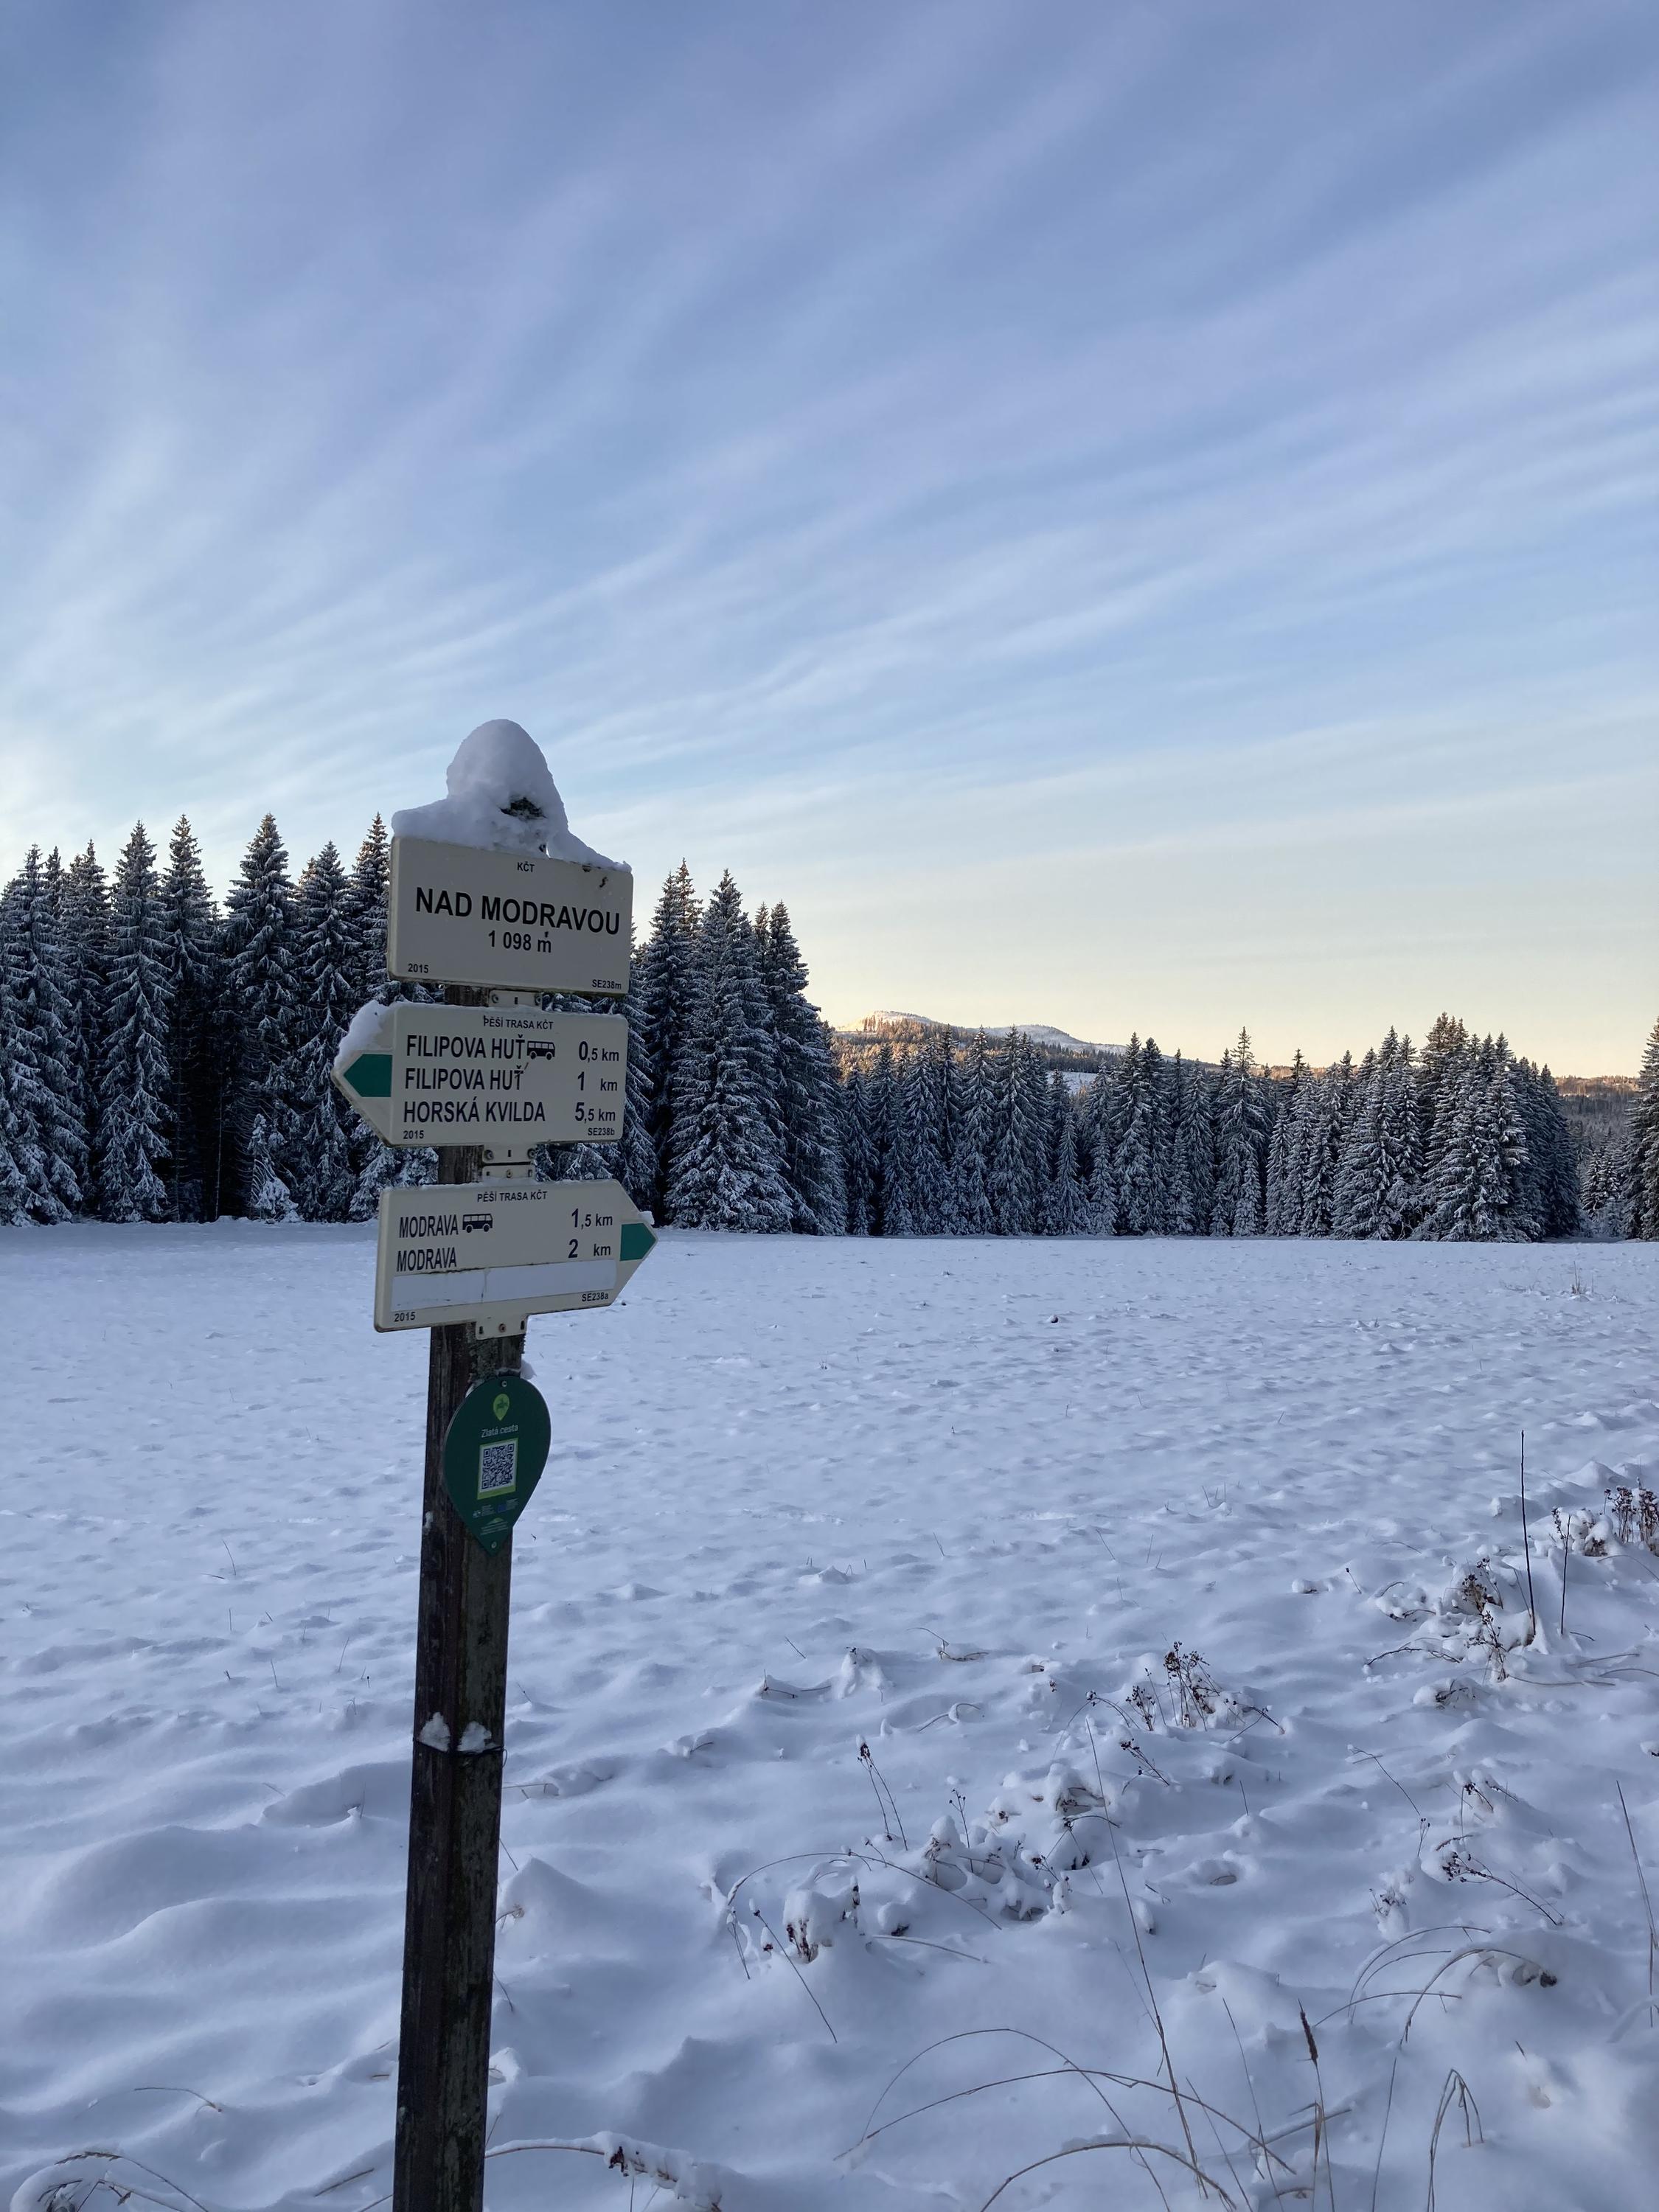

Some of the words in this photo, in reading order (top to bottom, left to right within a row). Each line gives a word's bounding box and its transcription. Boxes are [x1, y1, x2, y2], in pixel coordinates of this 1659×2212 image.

[517, 860, 535, 874] KČT
[416, 886, 472, 917] NAD
[481, 895, 620, 935] MODRAVOU
[488, 931, 495, 947] 1
[503, 933, 532, 951] 098
[537, 937, 552, 953] m
[408, 963, 429, 974] 2015
[591, 978, 622, 990] SE238m
[505, 1019, 535, 1029] TRASA
[536, 1018, 554, 1030] KČT
[406, 1034, 487, 1059] FILIPOVA
[491, 1034, 526, 1060] HUŤ
[578, 1040, 598, 1062] 0,5
[602, 1048, 619, 1062] km
[405, 1068, 484, 1090] FILIPOVA
[490, 1065, 524, 1091] HUŤ
[577, 1071, 585, 1091] 1
[600, 1079, 618, 1091] km
[403, 1096, 479, 1123] HORSKÁ
[485, 1102, 546, 1122] KVILDA
[575, 1102, 595, 1124] 5,5
[598, 1110, 616, 1121] km
[403, 1130, 424, 1140] 2015
[588, 1127, 615, 1136] SE238b
[499, 1192, 529, 1201] TRASA
[530, 1190, 547, 1201] KČT
[399, 1214, 459, 1239] MODRAVA
[571, 1208, 592, 1231] 1,5
[595, 1214, 613, 1227] km
[568, 1239, 579, 1259] 2
[593, 1245, 611, 1256] km
[396, 1247, 457, 1272] MODRAVA
[581, 1293, 609, 1303] SE238a
[394, 1312, 416, 1322] 2015
[481, 1427, 499, 1438] Zlatá
[500, 1424, 518, 1435] cesta
